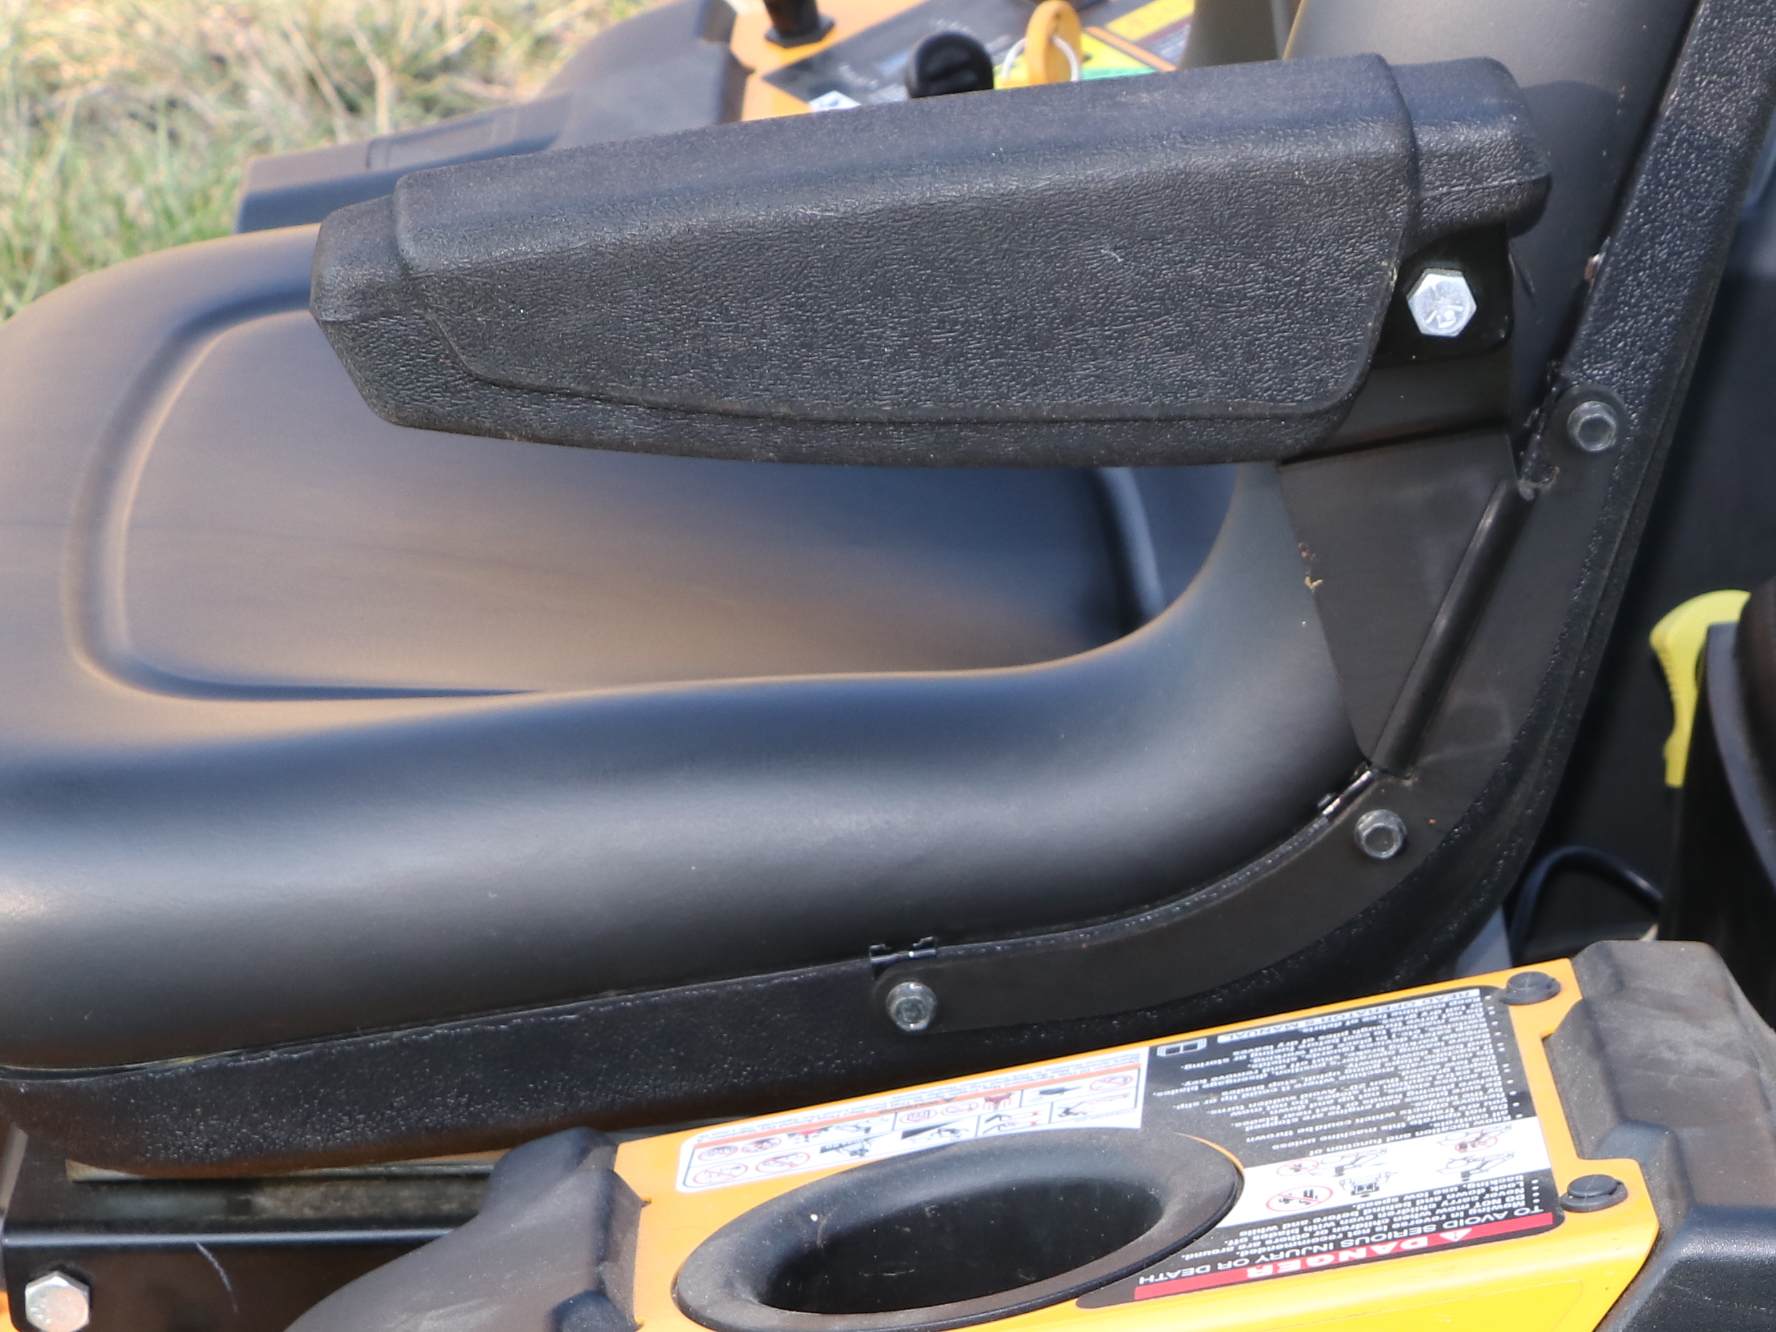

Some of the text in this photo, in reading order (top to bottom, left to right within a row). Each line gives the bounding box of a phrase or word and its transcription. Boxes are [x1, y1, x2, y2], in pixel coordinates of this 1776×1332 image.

[1408, 1110, 1461, 1126] operate
[1471, 1114, 1512, 1127] Know
[1379, 1121, 1406, 1131] this
[1413, 1121, 1470, 1137] location
[1318, 1126, 1377, 1142] machine
[1271, 1137, 1316, 1150] unless
[1325, 1137, 1382, 1153] function
[1461, 1173, 1524, 1191] backing,
[1488, 1180, 1525, 1192] Look
[1445, 1187, 1486, 1200] down
[1351, 1195, 1399, 1210] speed.
[1362, 1200, 1412, 1215] behind
[1223, 1186, 1525, 1247] Never carry children even with blades off.
[1311, 1209, 1359, 1224] before
[1392, 1210, 1432, 1223] when
[1234, 1198, 1526, 1257] Mowing in reverse is not recommended.
[1238, 1224, 1279, 1237] while
[1331, 1217, 1390, 1234] children
[1138, 1204, 1544, 1284] TO AVOID SERIOUS INJURY OR DEATH
[1264, 1231, 1310, 1246] others
[1180, 1245, 1235, 1261] around.
[1245, 1235, 1429, 1279] DANGER
